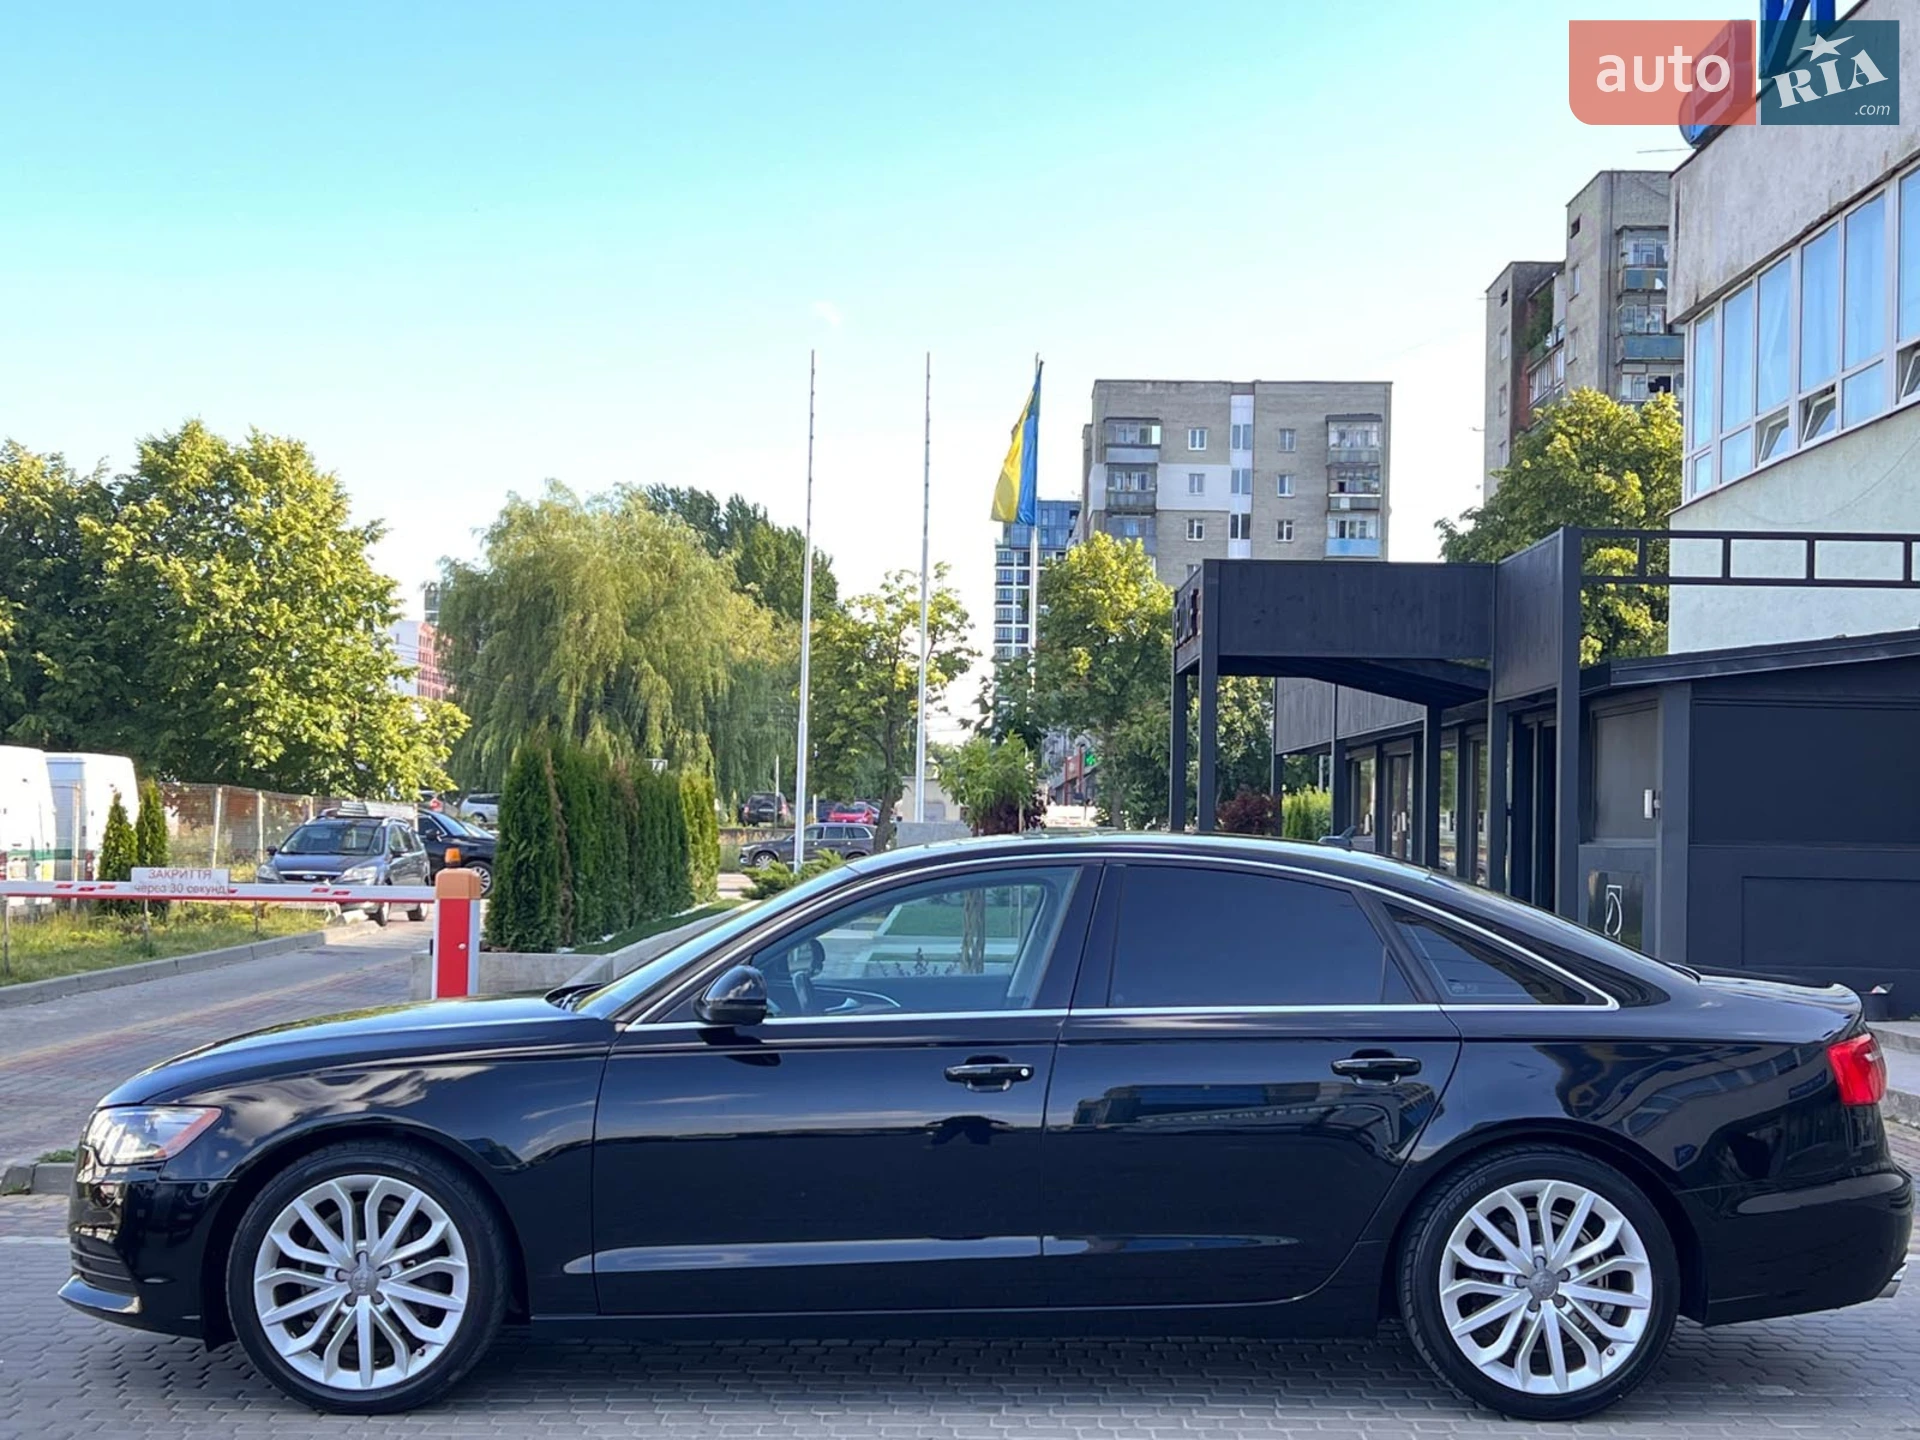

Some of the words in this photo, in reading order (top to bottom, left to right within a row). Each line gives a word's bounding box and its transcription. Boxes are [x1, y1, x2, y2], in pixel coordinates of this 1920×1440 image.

[148, 869, 212, 879] ЗАКРИТТЯ
[134, 885, 167, 895] через
[170, 883, 184, 894] 30
